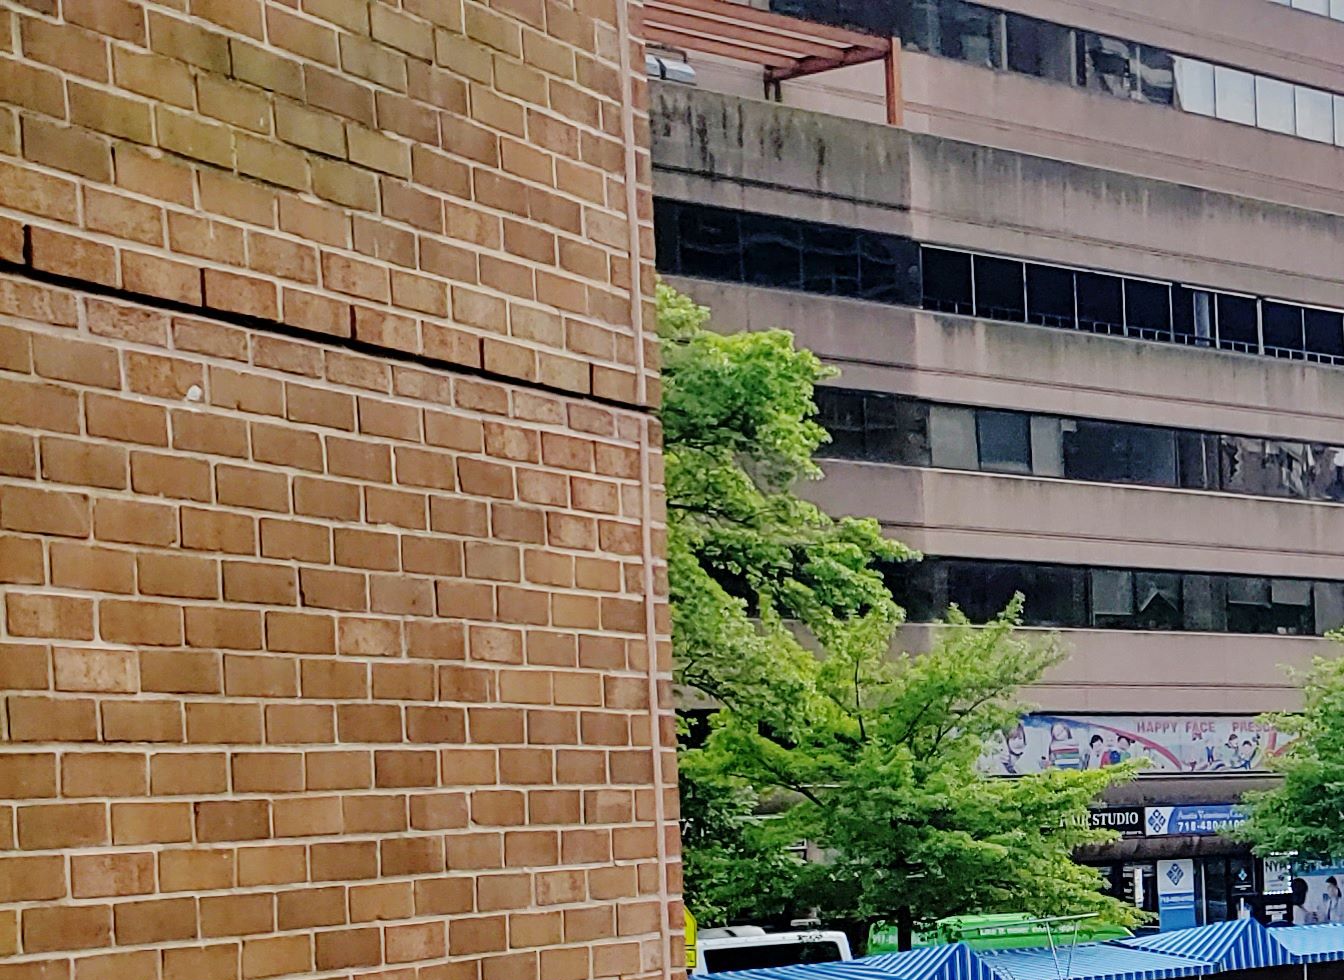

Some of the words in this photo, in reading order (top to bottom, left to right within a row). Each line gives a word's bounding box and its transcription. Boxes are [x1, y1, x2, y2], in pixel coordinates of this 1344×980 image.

[1136, 720, 1178, 733] HAPPY
[1185, 720, 1216, 733] FACE
[1092, 812, 1139, 826] STUDIO
